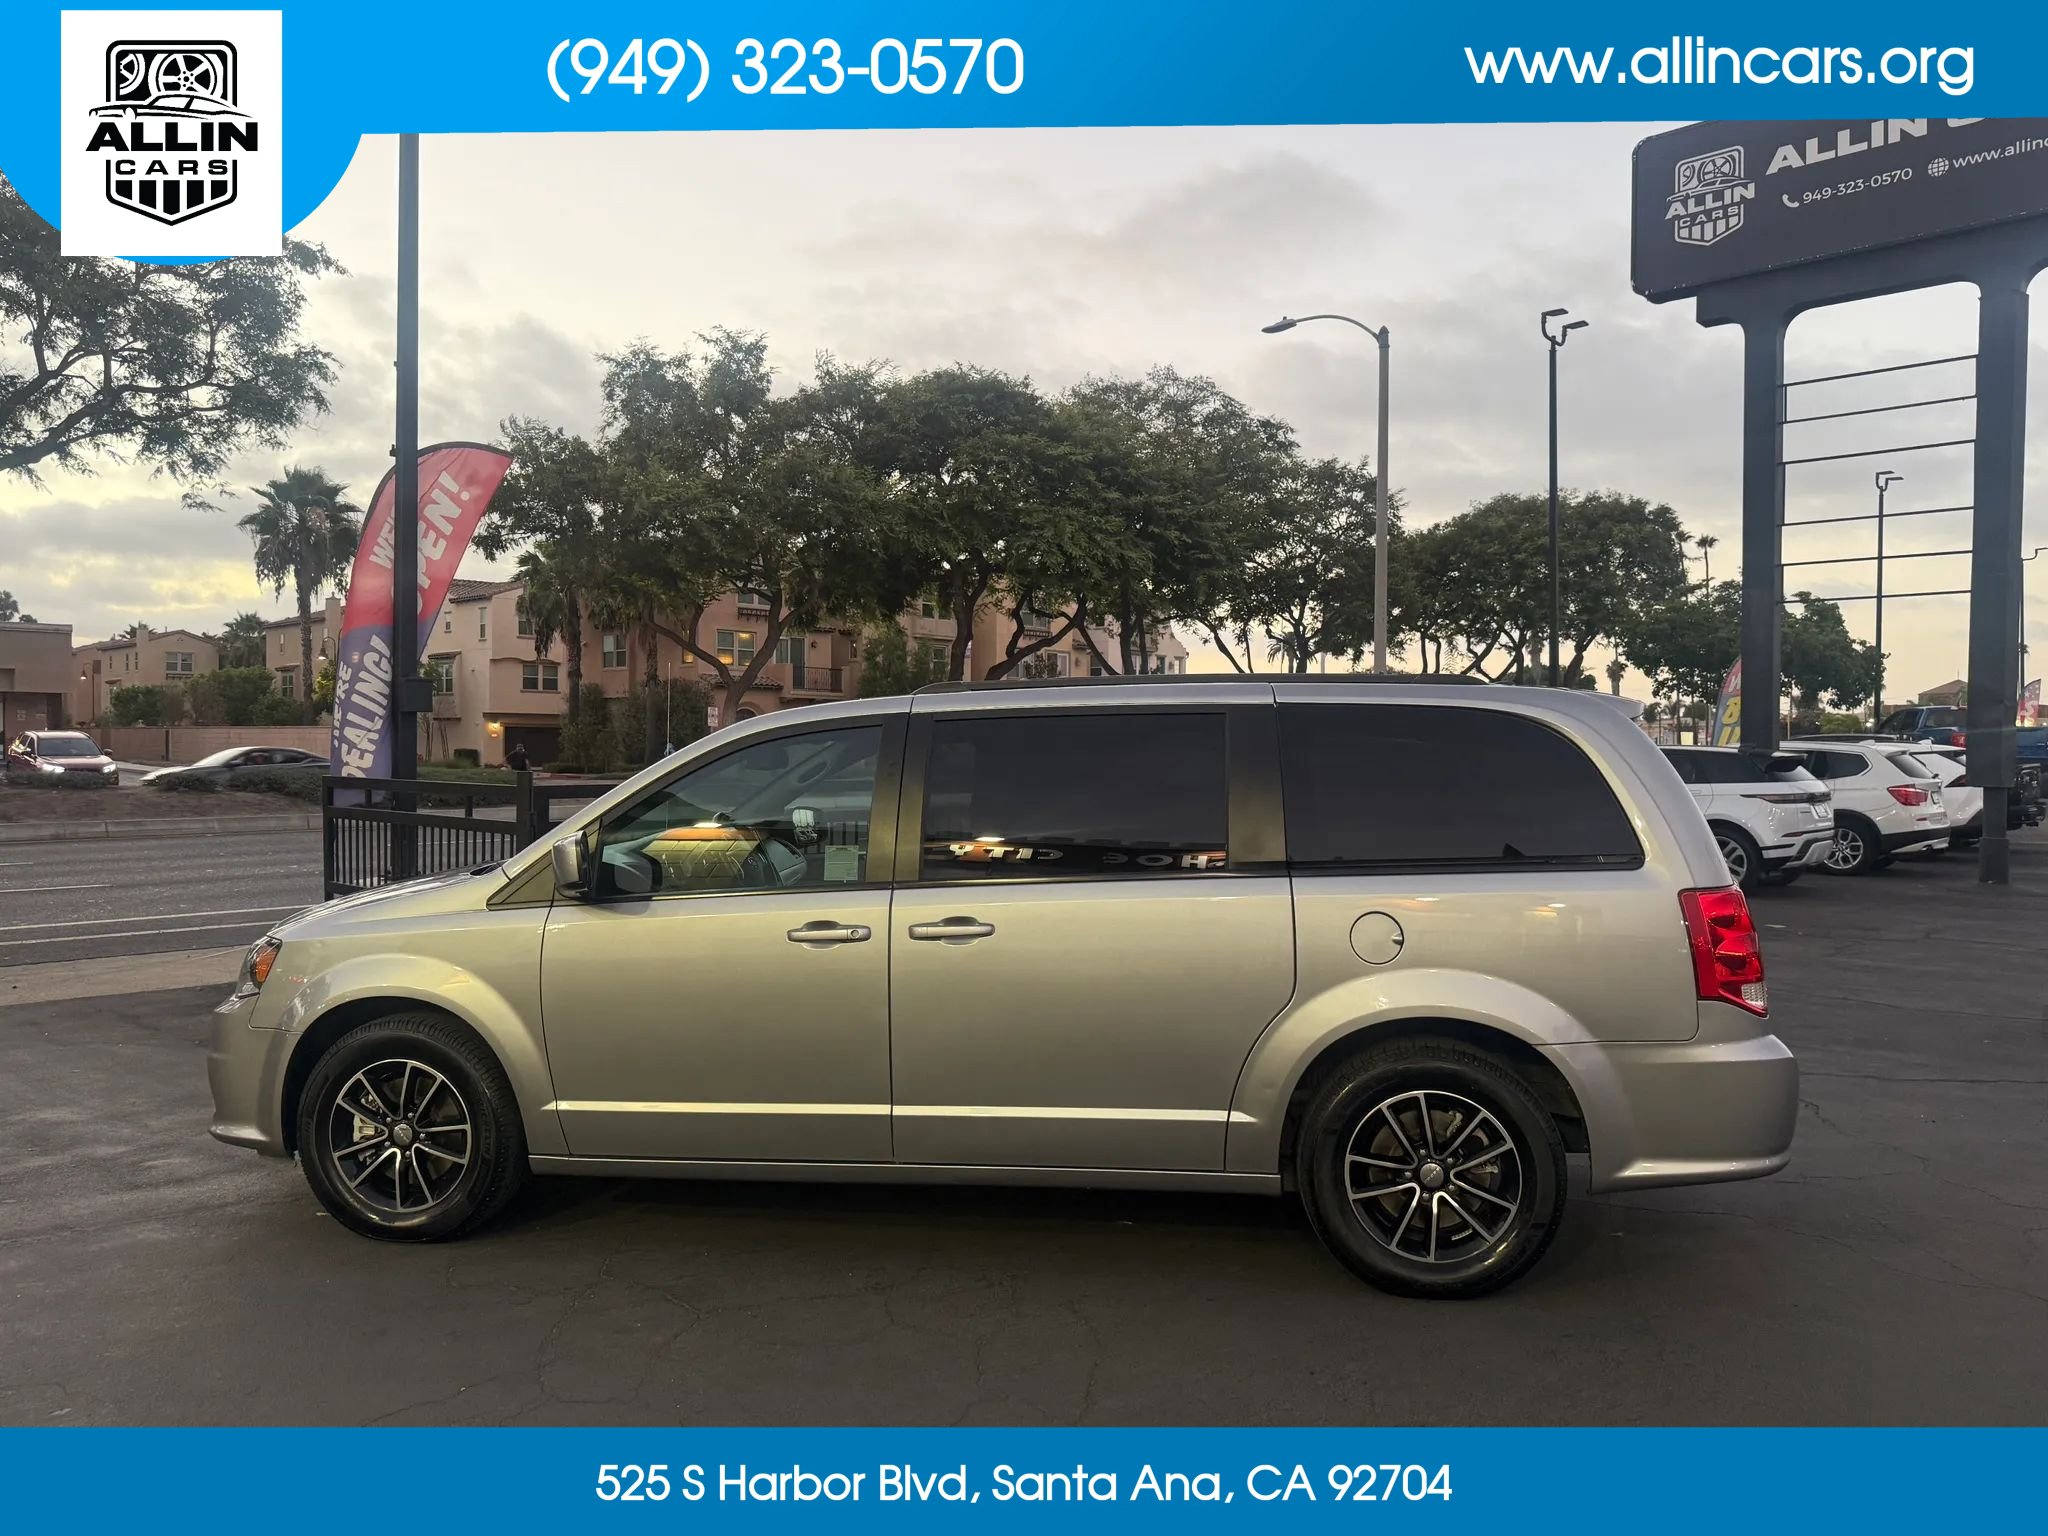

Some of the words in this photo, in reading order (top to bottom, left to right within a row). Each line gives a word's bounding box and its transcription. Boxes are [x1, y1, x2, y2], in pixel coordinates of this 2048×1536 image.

[1765, 118, 1928, 176] ALLIN
[1664, 182, 1756, 220] ALLIN
[1802, 166, 1913, 204] 949-323-0570
[1679, 205, 1740, 227] CARS
[392, 470, 470, 614] PEN!
